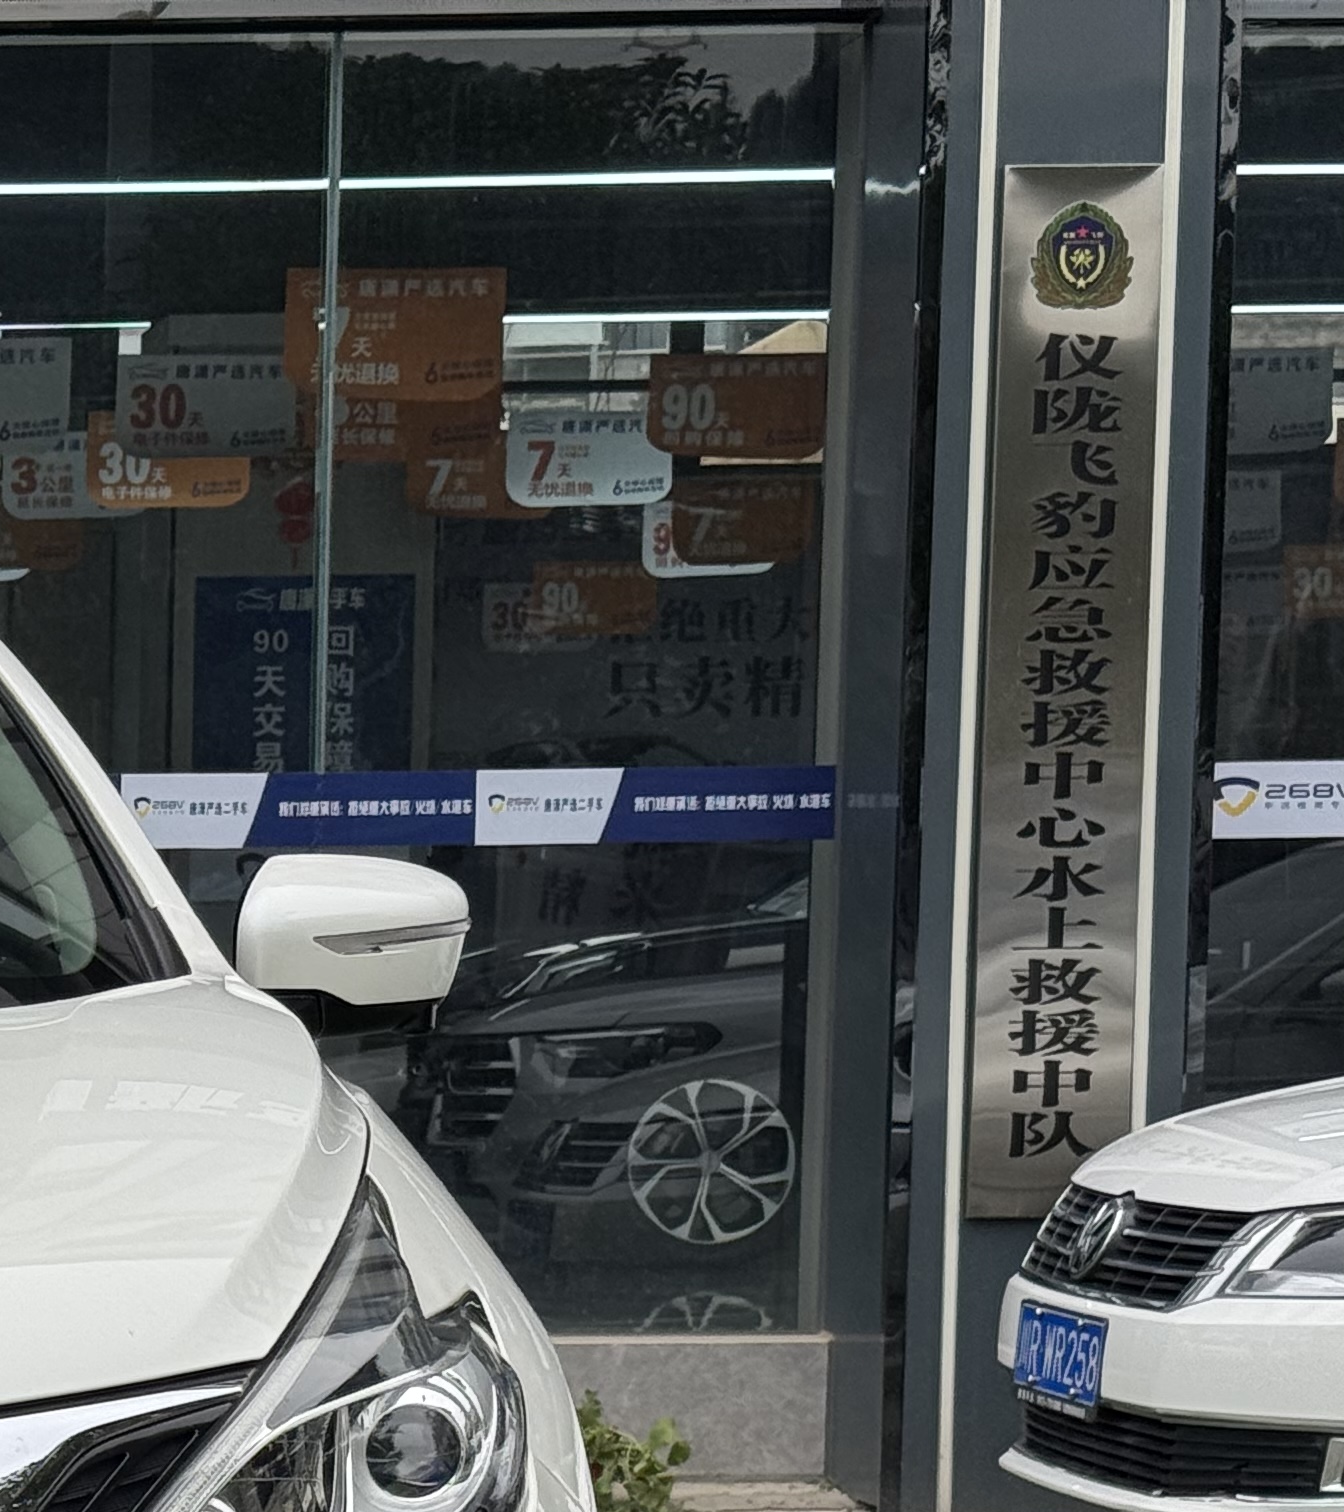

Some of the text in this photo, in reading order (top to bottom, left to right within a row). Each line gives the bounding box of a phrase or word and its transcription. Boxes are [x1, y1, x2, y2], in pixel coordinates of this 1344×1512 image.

[424, 361, 438, 385] 6
[352, 401, 398, 425] 公里
[0, 420, 10, 441] 6
[230, 429, 241, 448] 6
[10, 456, 75, 494] 3 公里
[527, 482, 594, 498] 无忧退换
[613, 480, 623, 496] 6
[1009, 332, 1123, 1157] 仪陇飞豹应急救援中心水上救援中队
